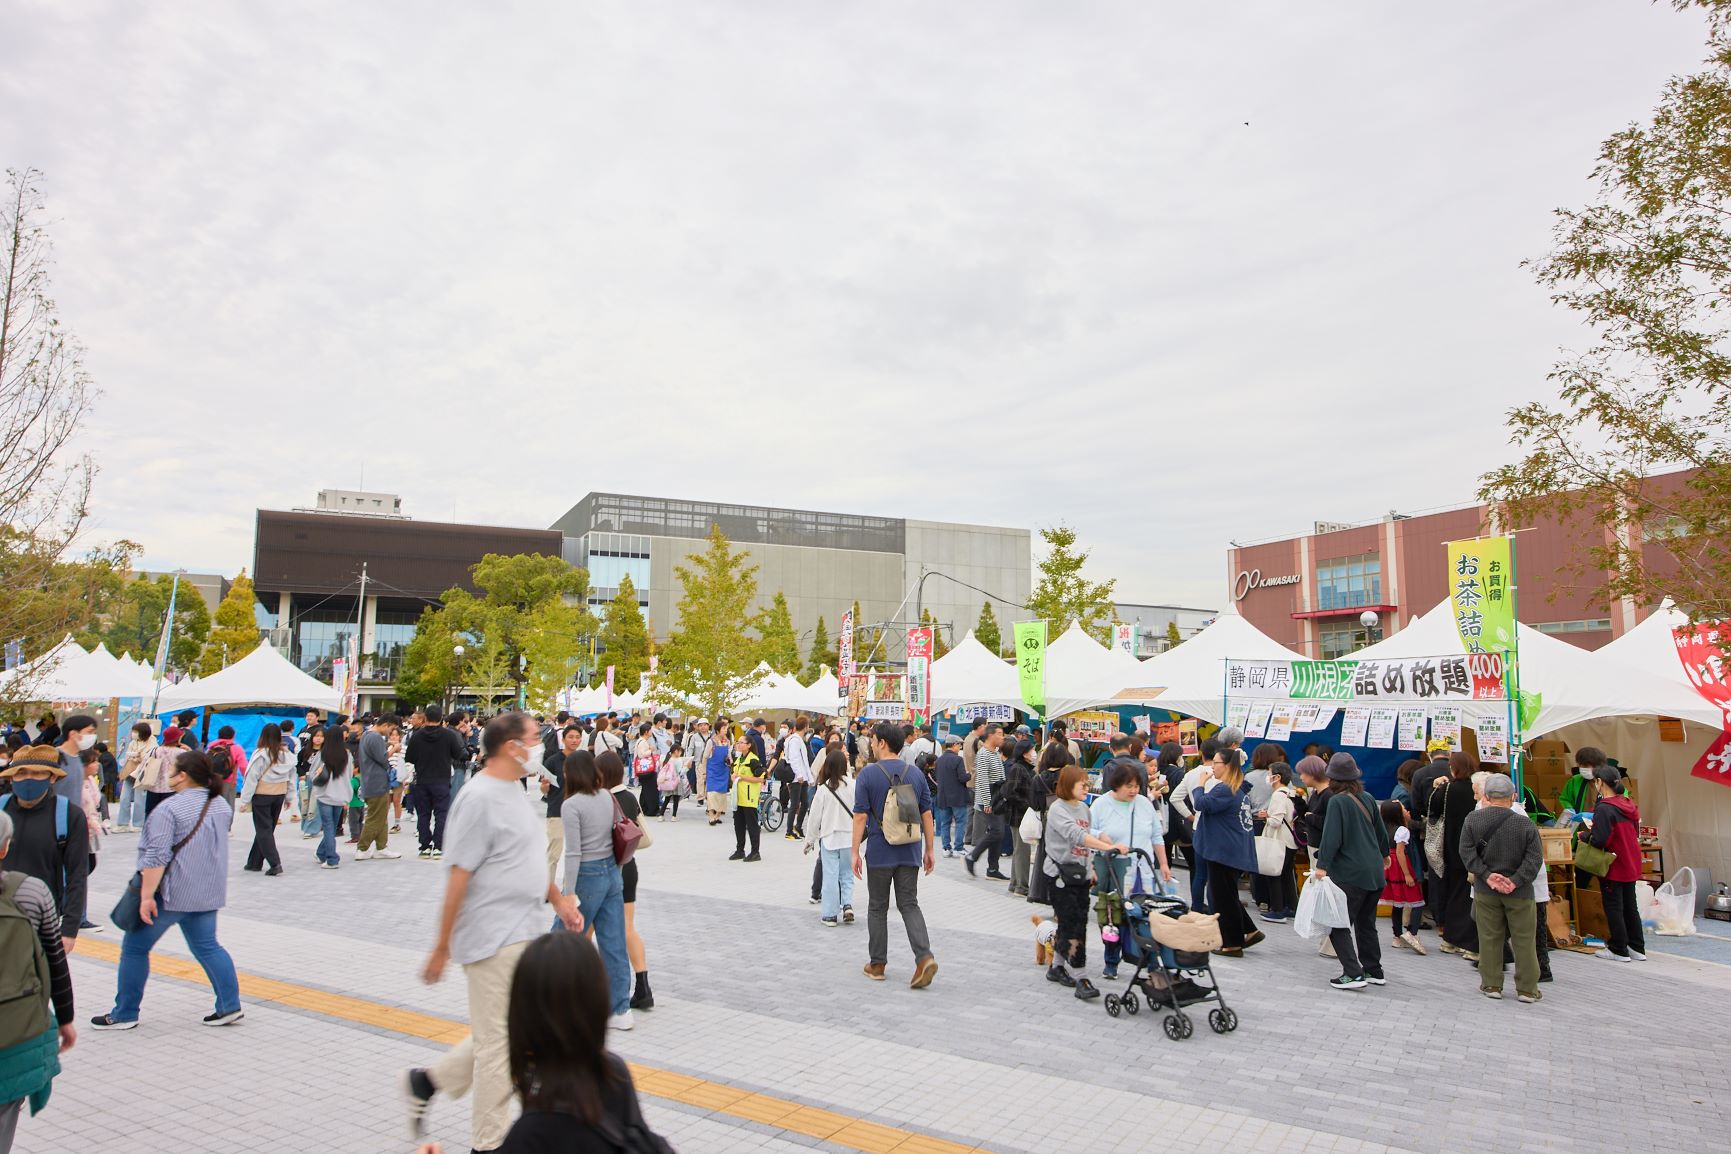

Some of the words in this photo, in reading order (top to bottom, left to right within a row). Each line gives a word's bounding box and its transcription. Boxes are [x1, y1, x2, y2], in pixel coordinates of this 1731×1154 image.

[1259, 574, 1301, 588] KAWASAKI
[1489, 560, 1502, 601] お買得
[1471, 654, 1502, 680] 400
